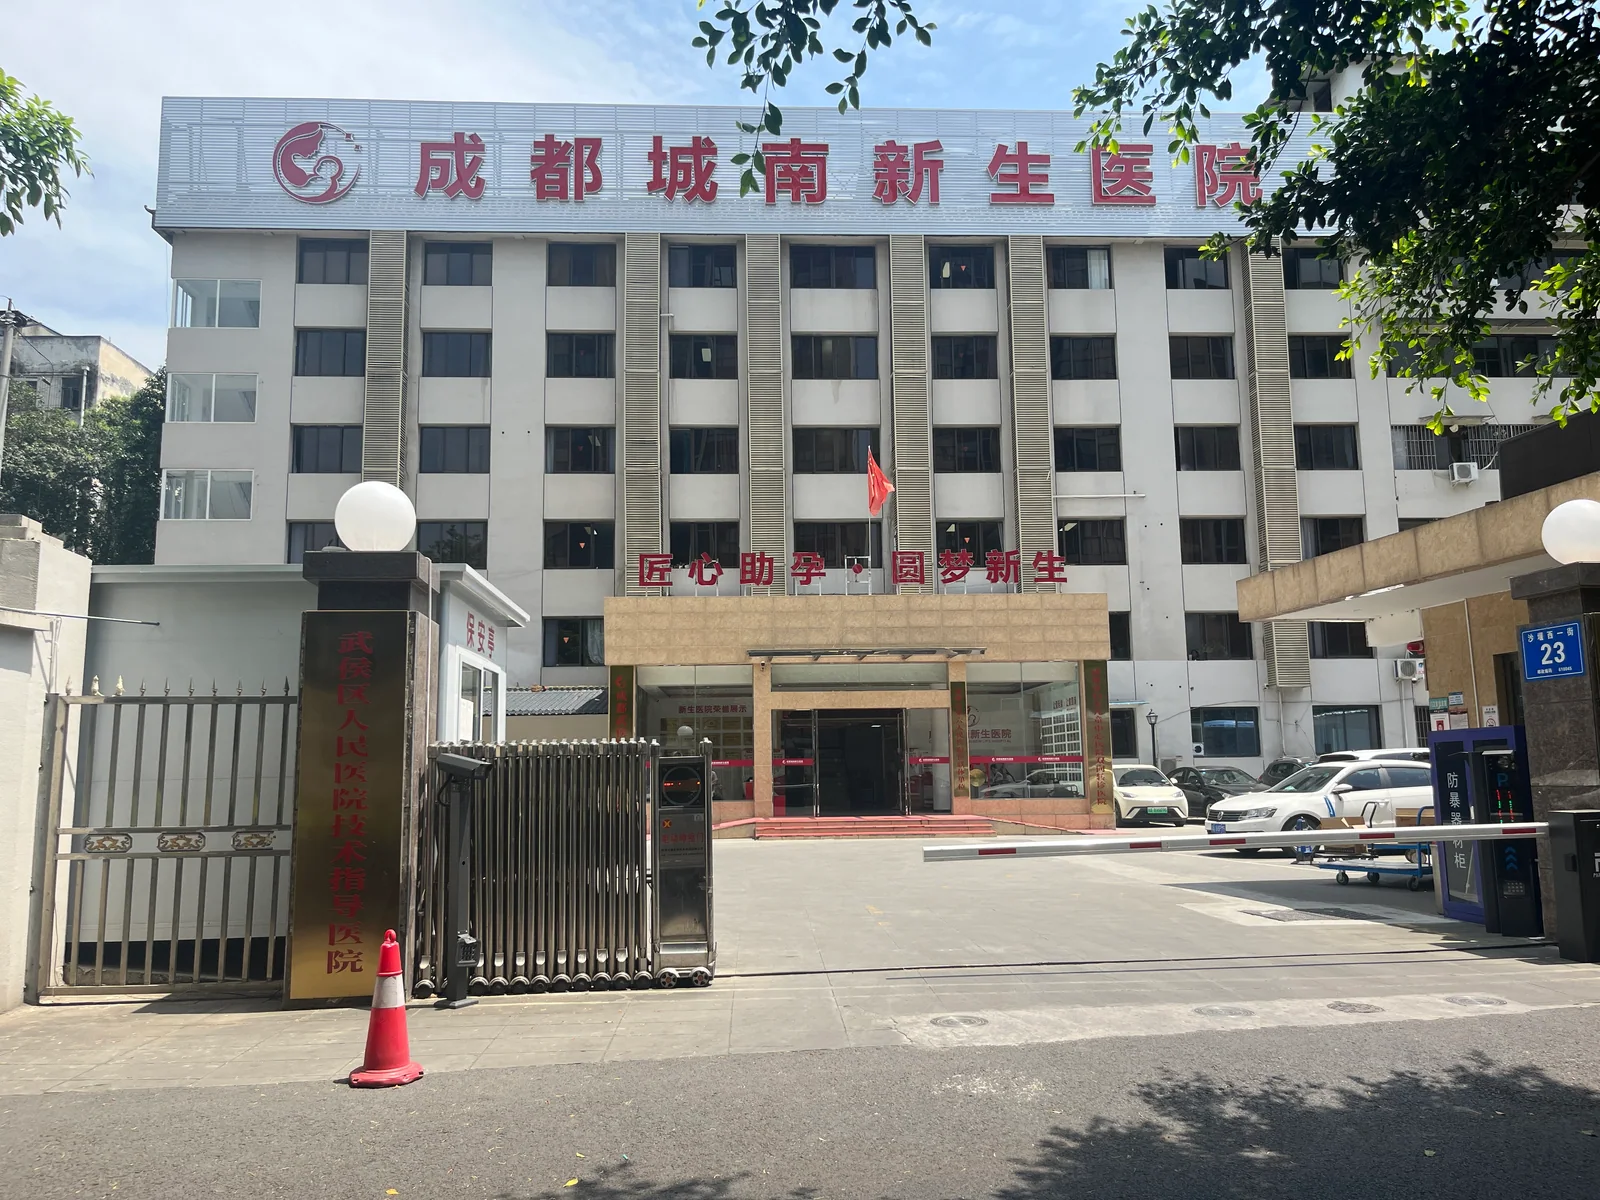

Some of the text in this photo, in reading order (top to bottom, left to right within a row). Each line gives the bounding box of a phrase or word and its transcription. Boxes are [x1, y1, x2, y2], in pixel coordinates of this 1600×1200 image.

[413, 132, 1264, 207] 成都城南新生医院
[466, 611, 495, 659] 保安亭
[1540, 641, 1566, 665] 23
[968, 728, 1012, 739] 新生医院
[326, 631, 374, 975] 武侯区人民医院技术指导医院
